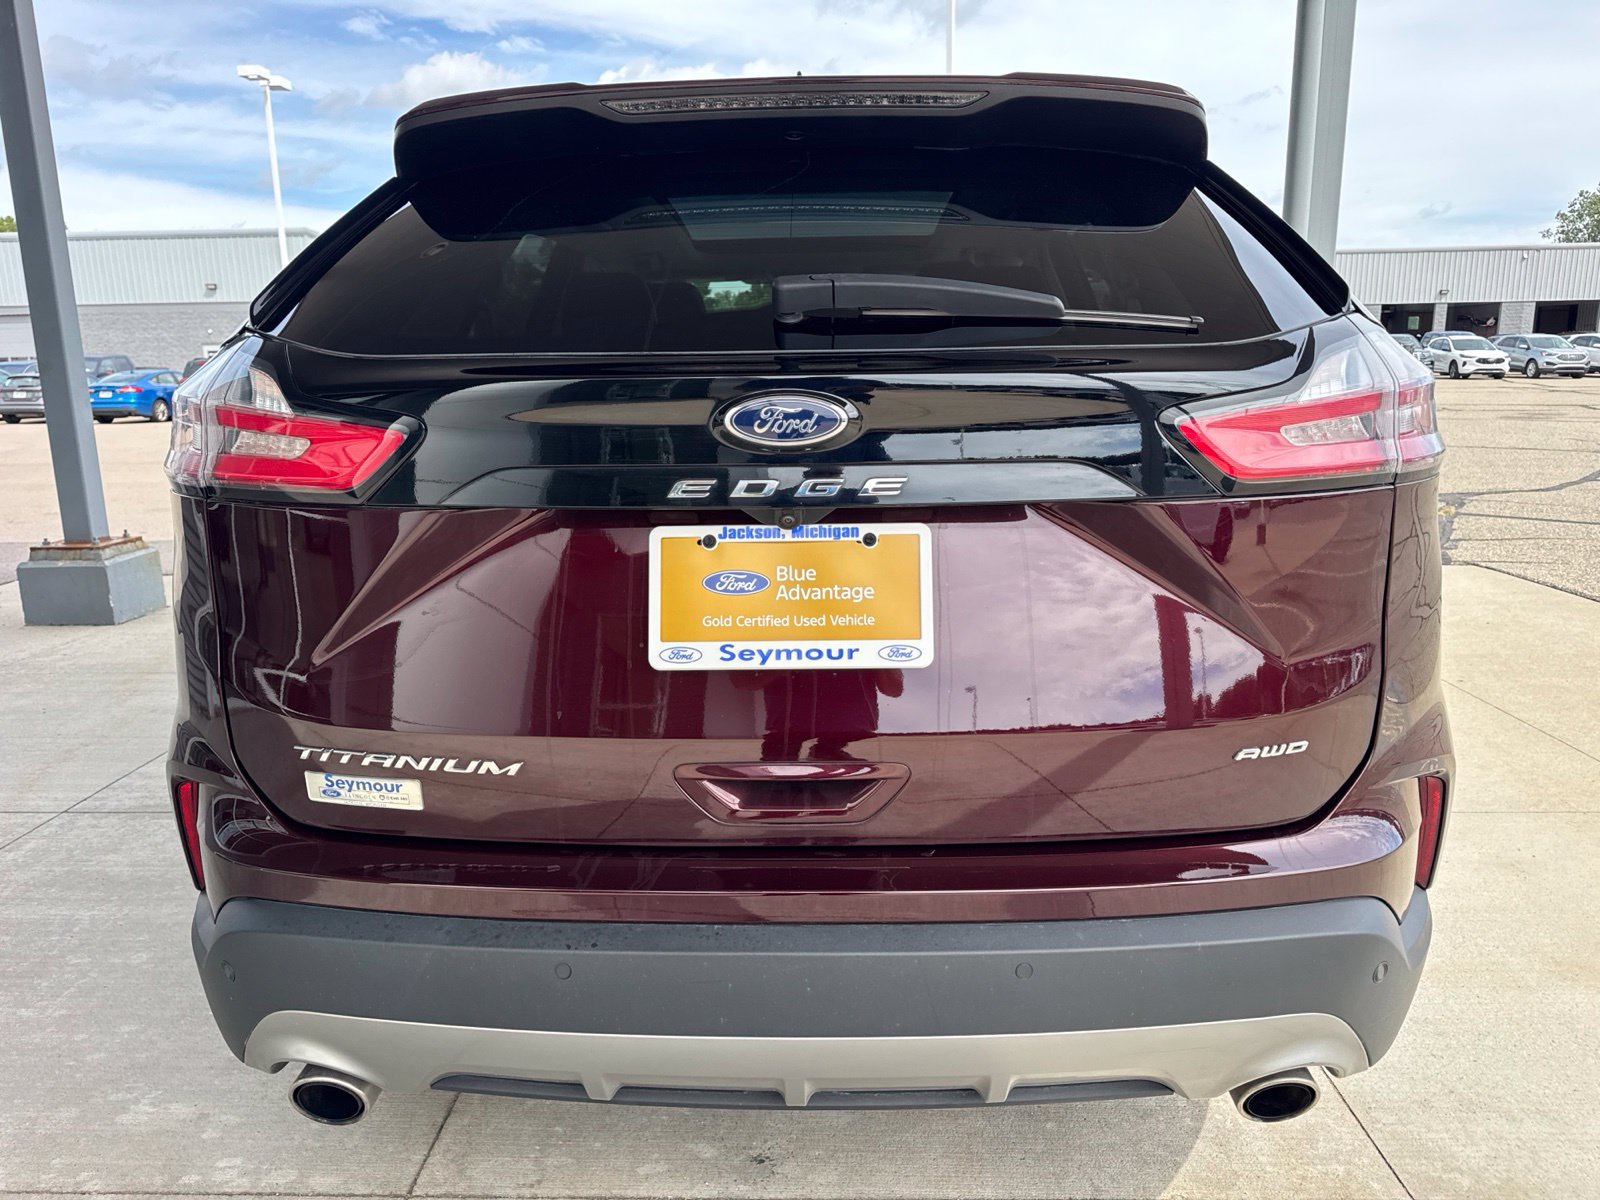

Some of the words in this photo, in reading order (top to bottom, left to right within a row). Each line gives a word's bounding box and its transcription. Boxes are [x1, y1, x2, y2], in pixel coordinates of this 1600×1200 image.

[754, 405, 818, 434] Ford
[667, 477, 908, 498] EDGE
[718, 526, 786, 540] Jackson,
[791, 525, 860, 540] Michigan
[715, 573, 758, 592] Ford
[776, 565, 817, 582] Blue
[776, 584, 875, 603] Advantage
[702, 615, 733, 627] Gold
[736, 615, 790, 627] Certified
[794, 615, 826, 627] Used
[829, 614, 876, 626] Vehicle
[668, 649, 694, 661] Ford
[719, 643, 860, 666] Seymour
[887, 648, 914, 660] Ford
[293, 745, 524, 776] TITANIUM
[1233, 740, 1310, 761] AWD
[324, 773, 403, 793] Seymour
